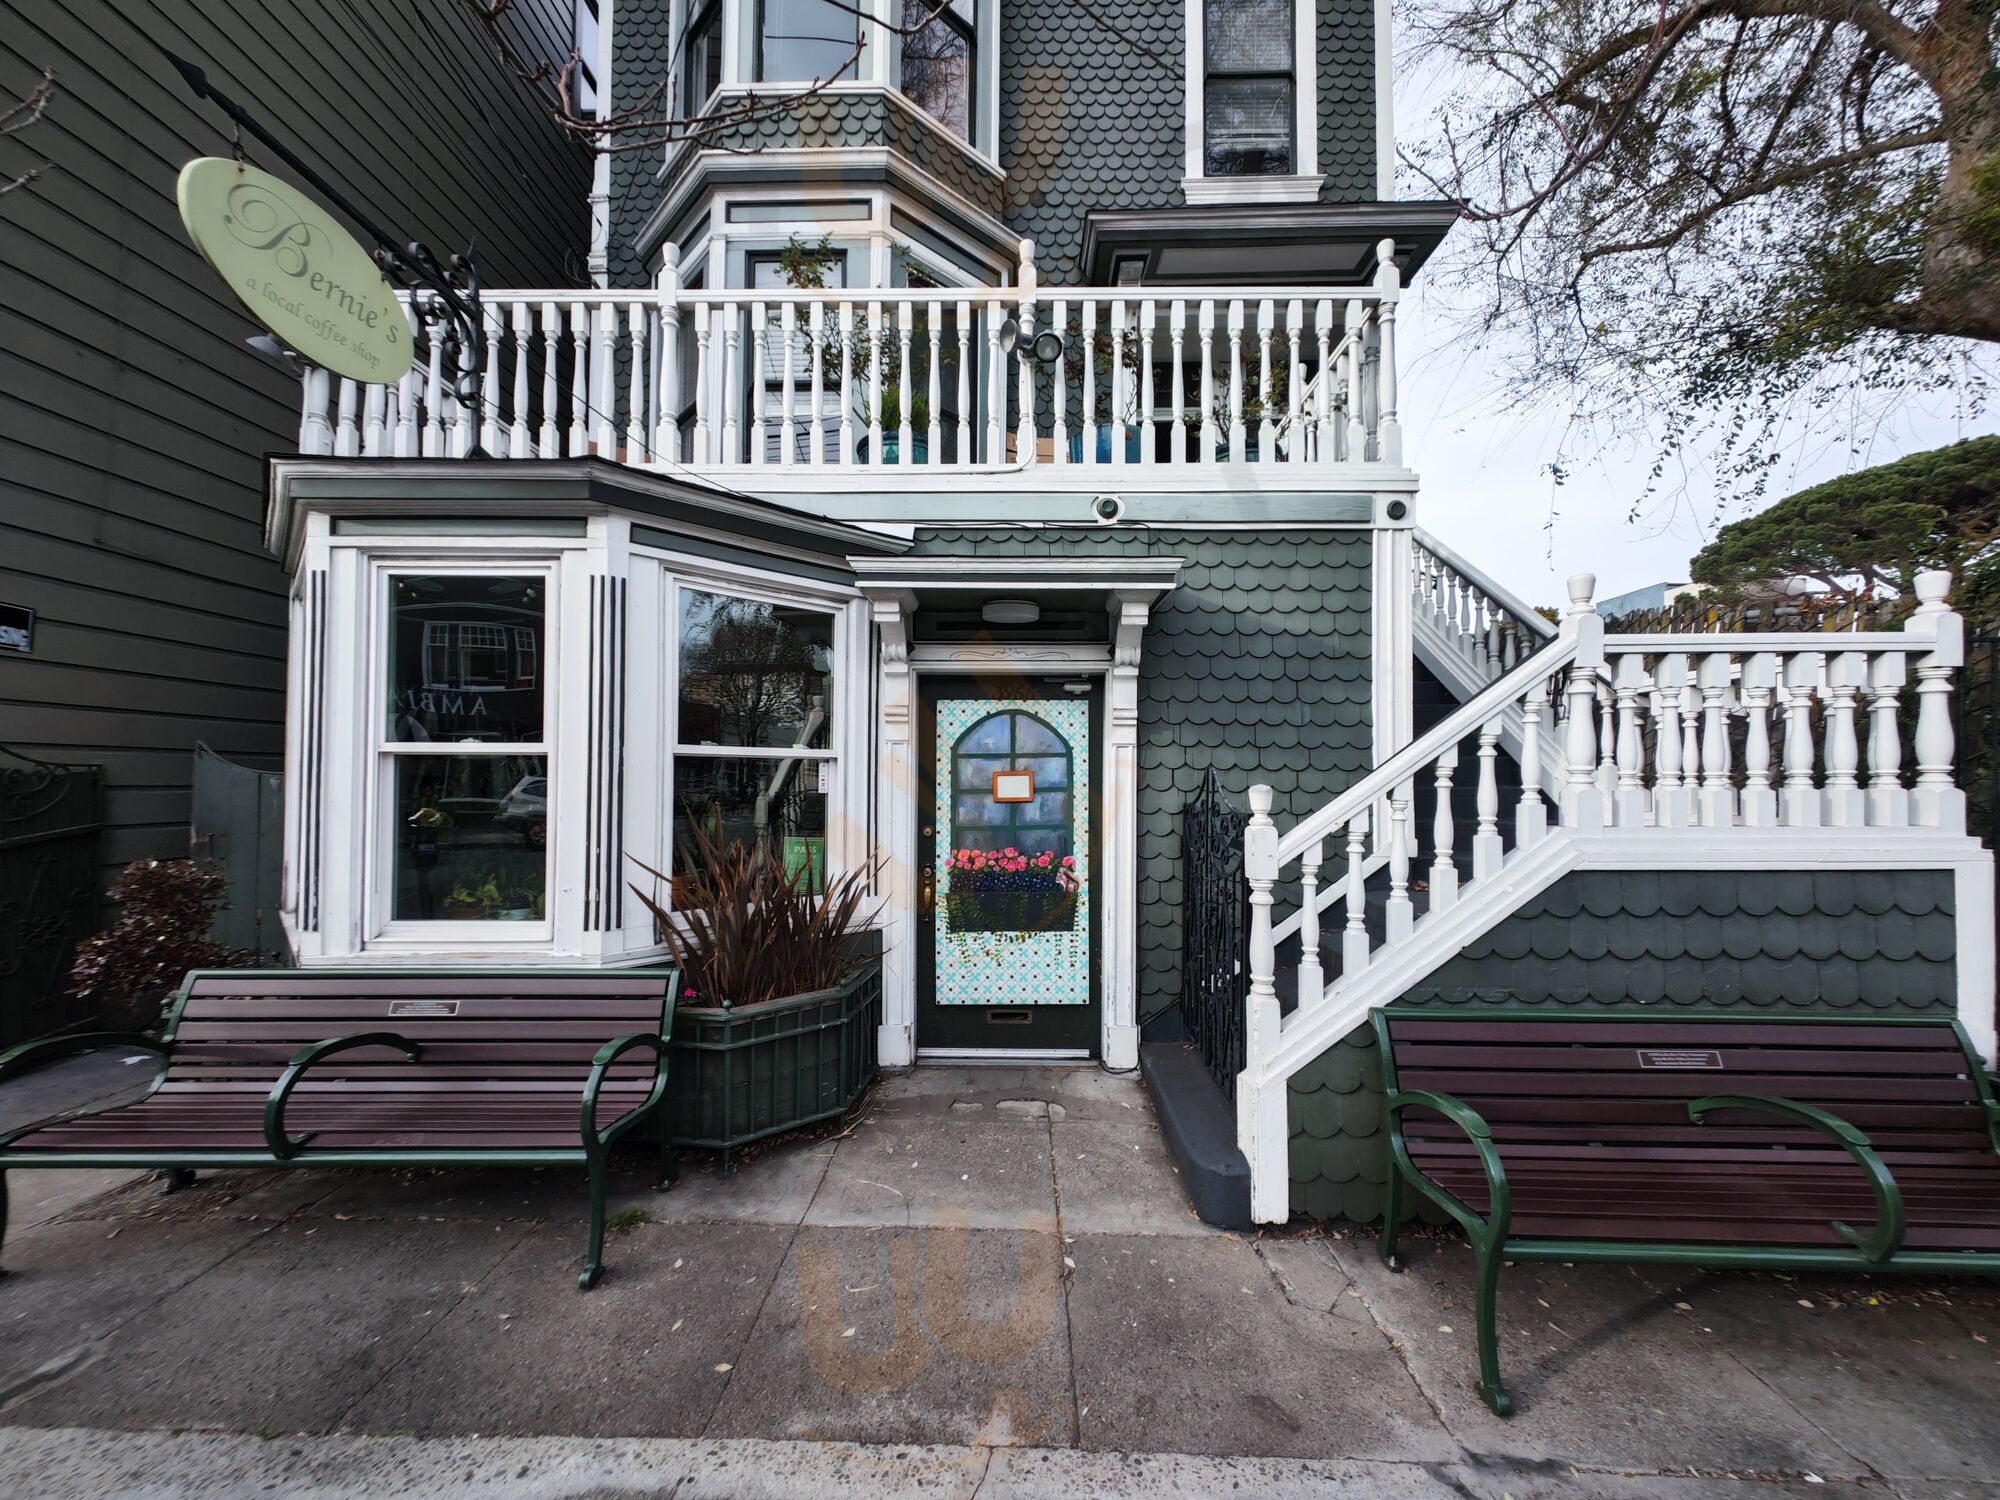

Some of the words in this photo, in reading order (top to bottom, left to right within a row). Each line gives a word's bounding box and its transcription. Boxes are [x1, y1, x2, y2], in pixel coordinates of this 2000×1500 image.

[223, 184, 398, 343] Bernie's
[246, 278, 257, 291] a
[262, 281, 303, 318] local
[304, 312, 347, 346] coffee
[351, 343, 380, 369] shop
